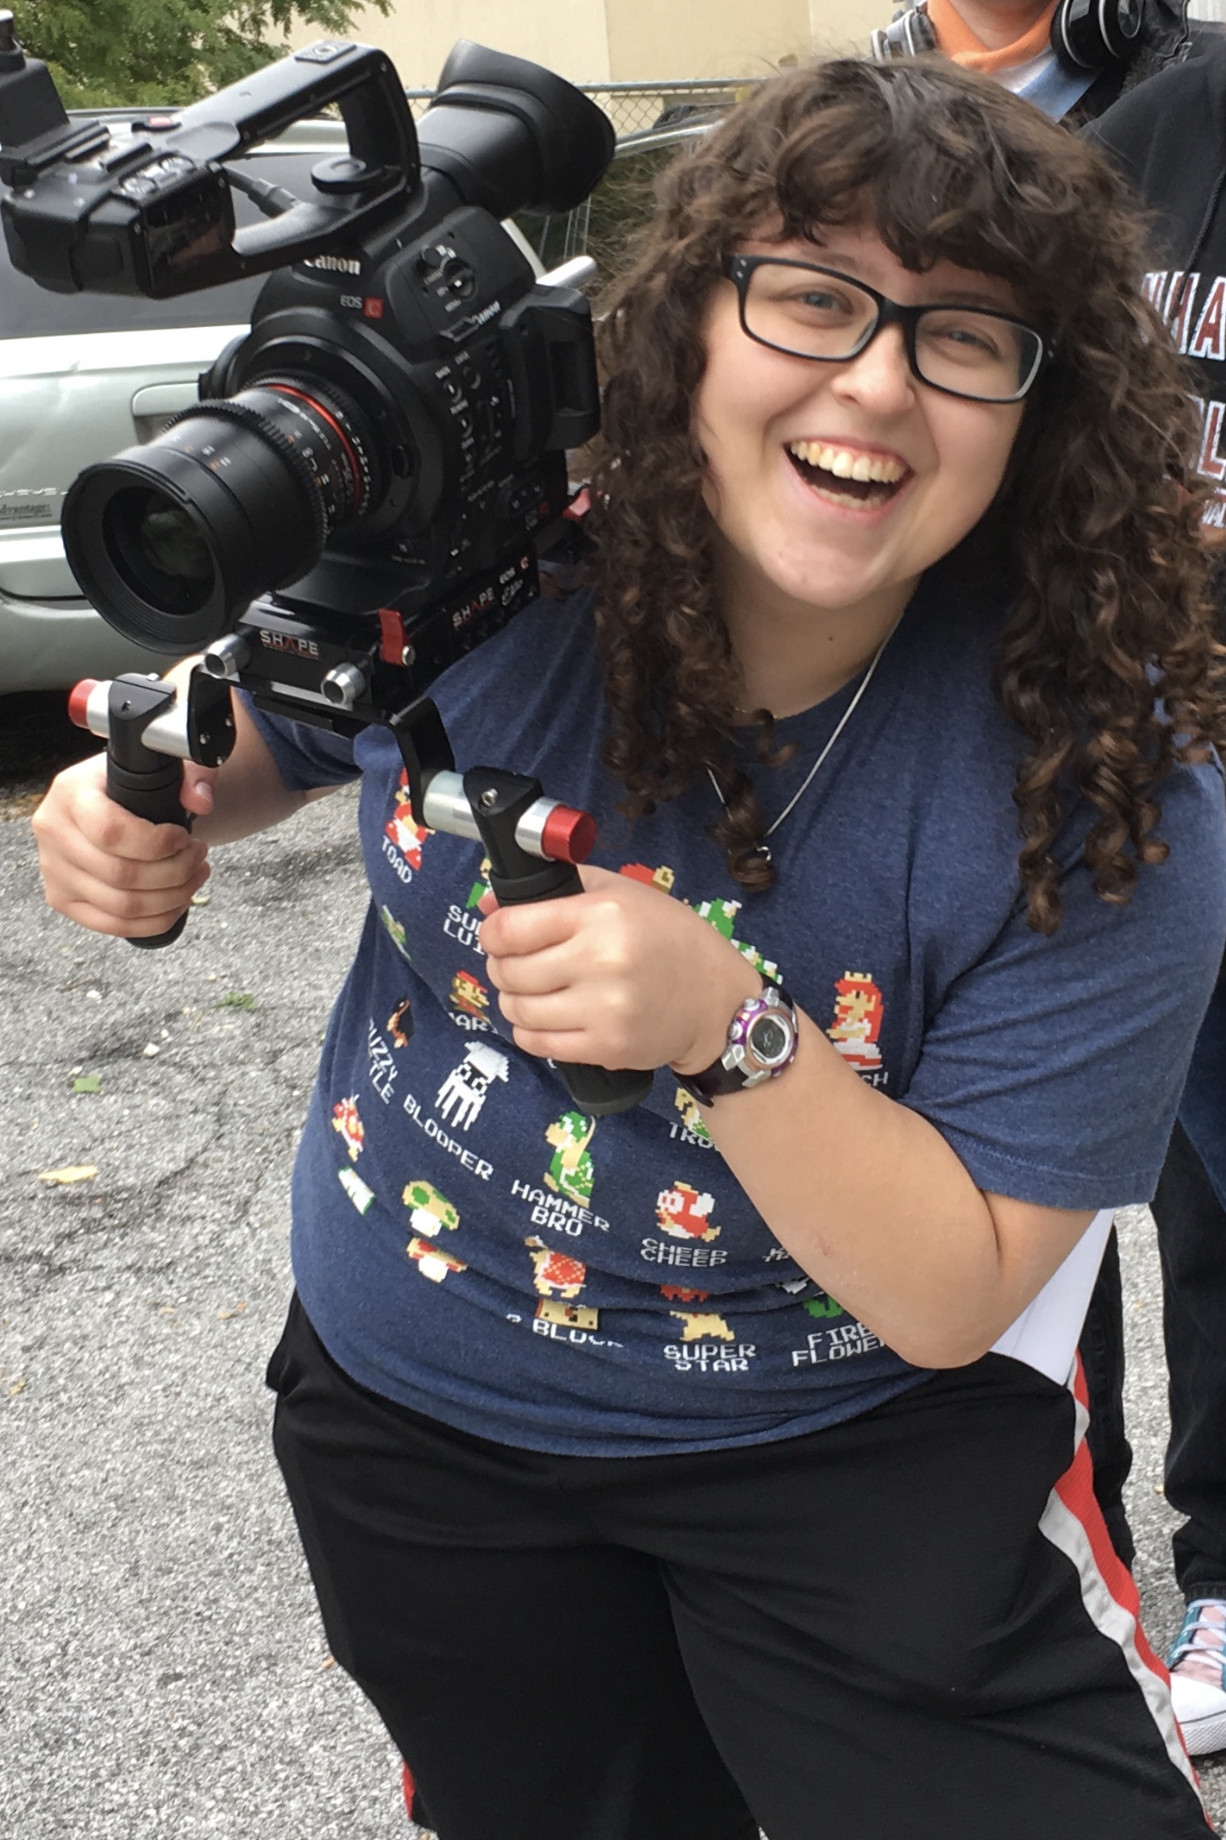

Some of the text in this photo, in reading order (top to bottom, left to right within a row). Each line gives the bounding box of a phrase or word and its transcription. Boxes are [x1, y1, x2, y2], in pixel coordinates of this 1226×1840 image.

[340, 295, 363, 309] EOS
[259, 630, 319, 656] SHAPE
[382, 834, 413, 884] TOAD
[403, 1093, 494, 1181] BLOOPER
[669, 1121, 719, 1151] TRO
[511, 1179, 610, 1232] HAMMER
[530, 1205, 583, 1237] BRO
[640, 1248, 727, 1268] CHEEP
[642, 1238, 728, 1258] CHEEP
[807, 1322, 875, 1350] FIRE
[663, 1344, 756, 1361] SUPER
[674, 1358, 749, 1372] STAR
